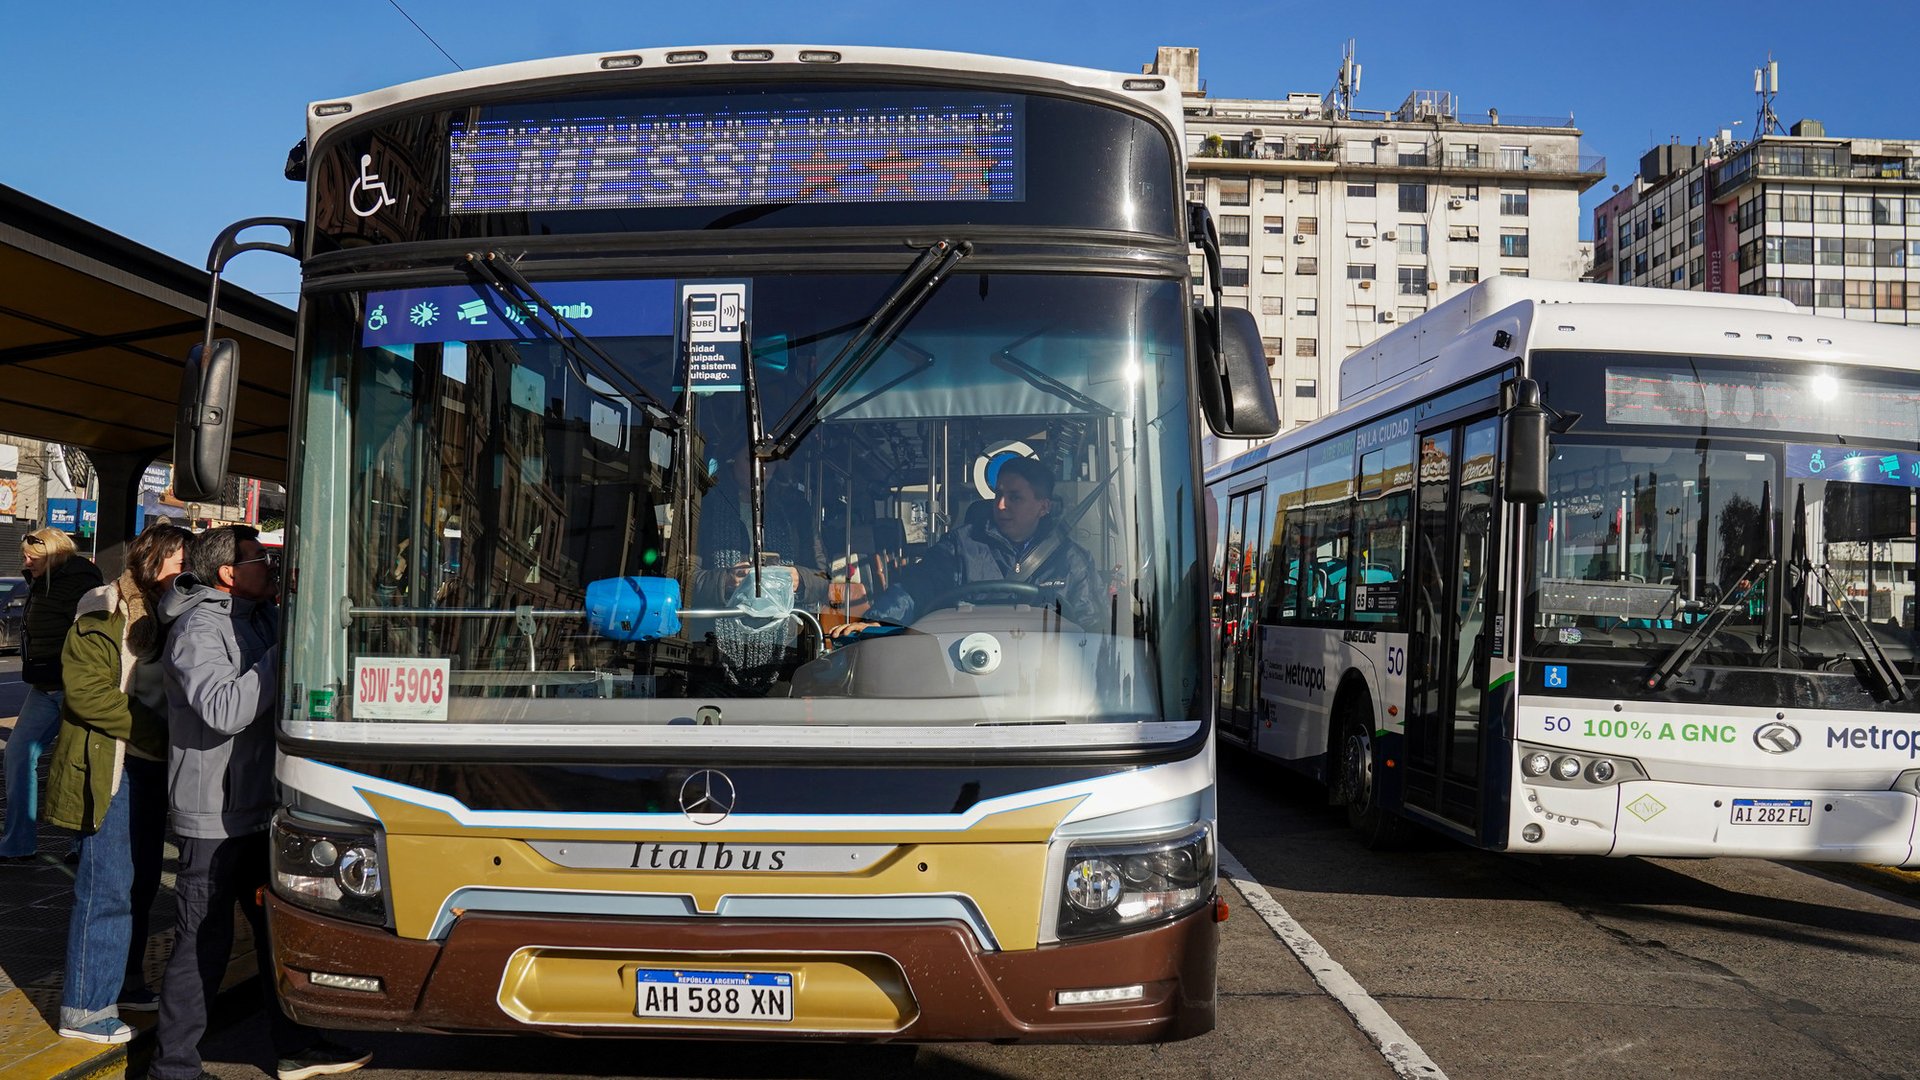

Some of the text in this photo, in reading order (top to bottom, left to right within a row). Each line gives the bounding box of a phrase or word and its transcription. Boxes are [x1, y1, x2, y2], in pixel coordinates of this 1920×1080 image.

[508, 140, 775, 207] MESSI
[691, 320, 713, 328] SUBE
[683, 354, 725, 364] quipada
[684, 344, 716, 353] nidad
[684, 372, 730, 381] ultipago.
[701, 362, 737, 371] sistema
[1357, 418, 1410, 450] EN LA CIUDAD
[1387, 646, 1404, 676] 50
[360, 667, 443, 704] SDW-5903
[1285, 661, 1327, 697] Metropol
[1544, 716, 1737, 743] 50 100% A GNC
[1634, 802, 1659, 815] CNG
[1735, 808, 1807, 823] AI 282 FL
[630, 842, 785, 871] Italbus
[678, 975, 750, 986] REPÚBLICA ARGENTINA
[645, 986, 784, 1015] AH 588 XN
